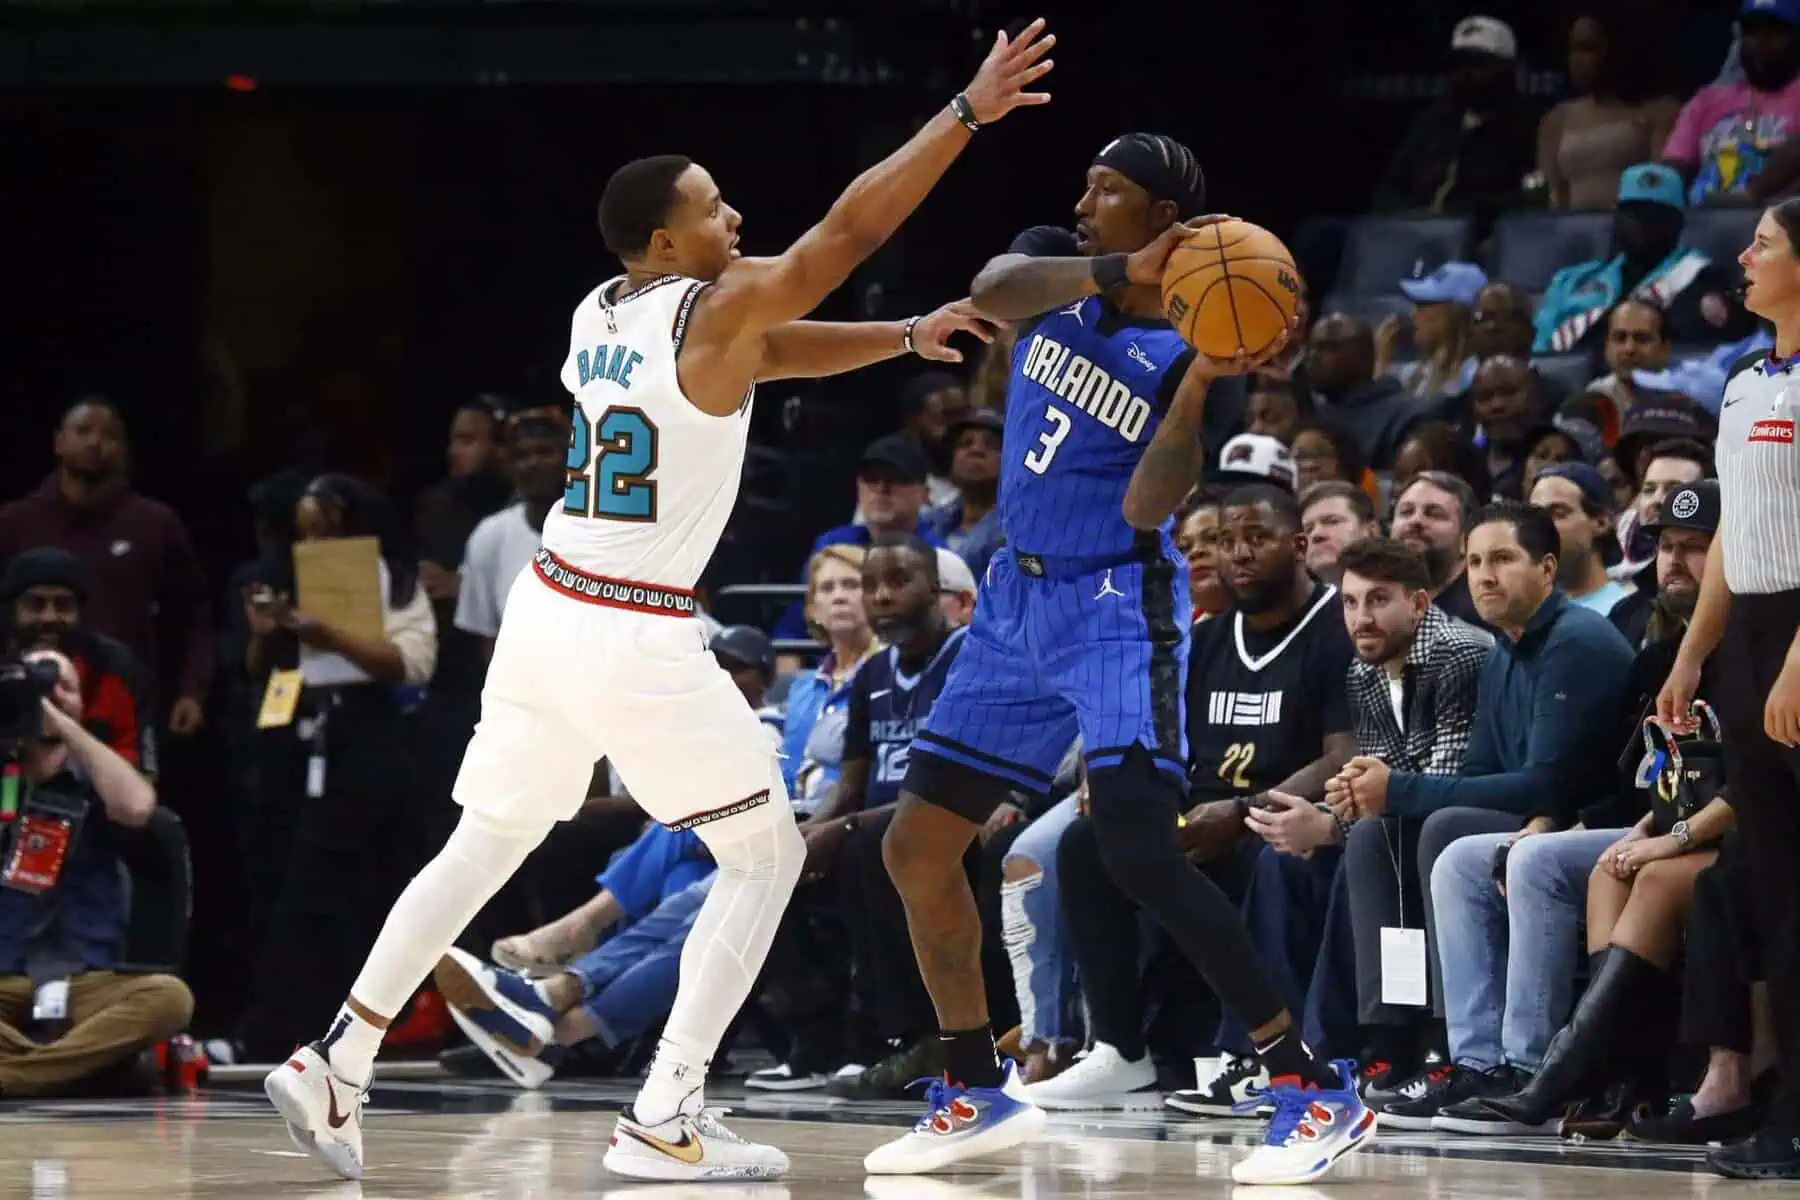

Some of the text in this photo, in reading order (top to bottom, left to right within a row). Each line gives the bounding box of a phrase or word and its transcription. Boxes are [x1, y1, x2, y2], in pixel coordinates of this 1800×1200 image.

[577, 344, 643, 390] BANE
[1127, 341, 1157, 372] Disney
[1022, 334, 1151, 443] ORLANDO
[1024, 405, 1071, 475] 3
[1750, 423, 1792, 438] Emirates
[563, 401, 658, 522] 22
[1218, 742, 1255, 788] 22
